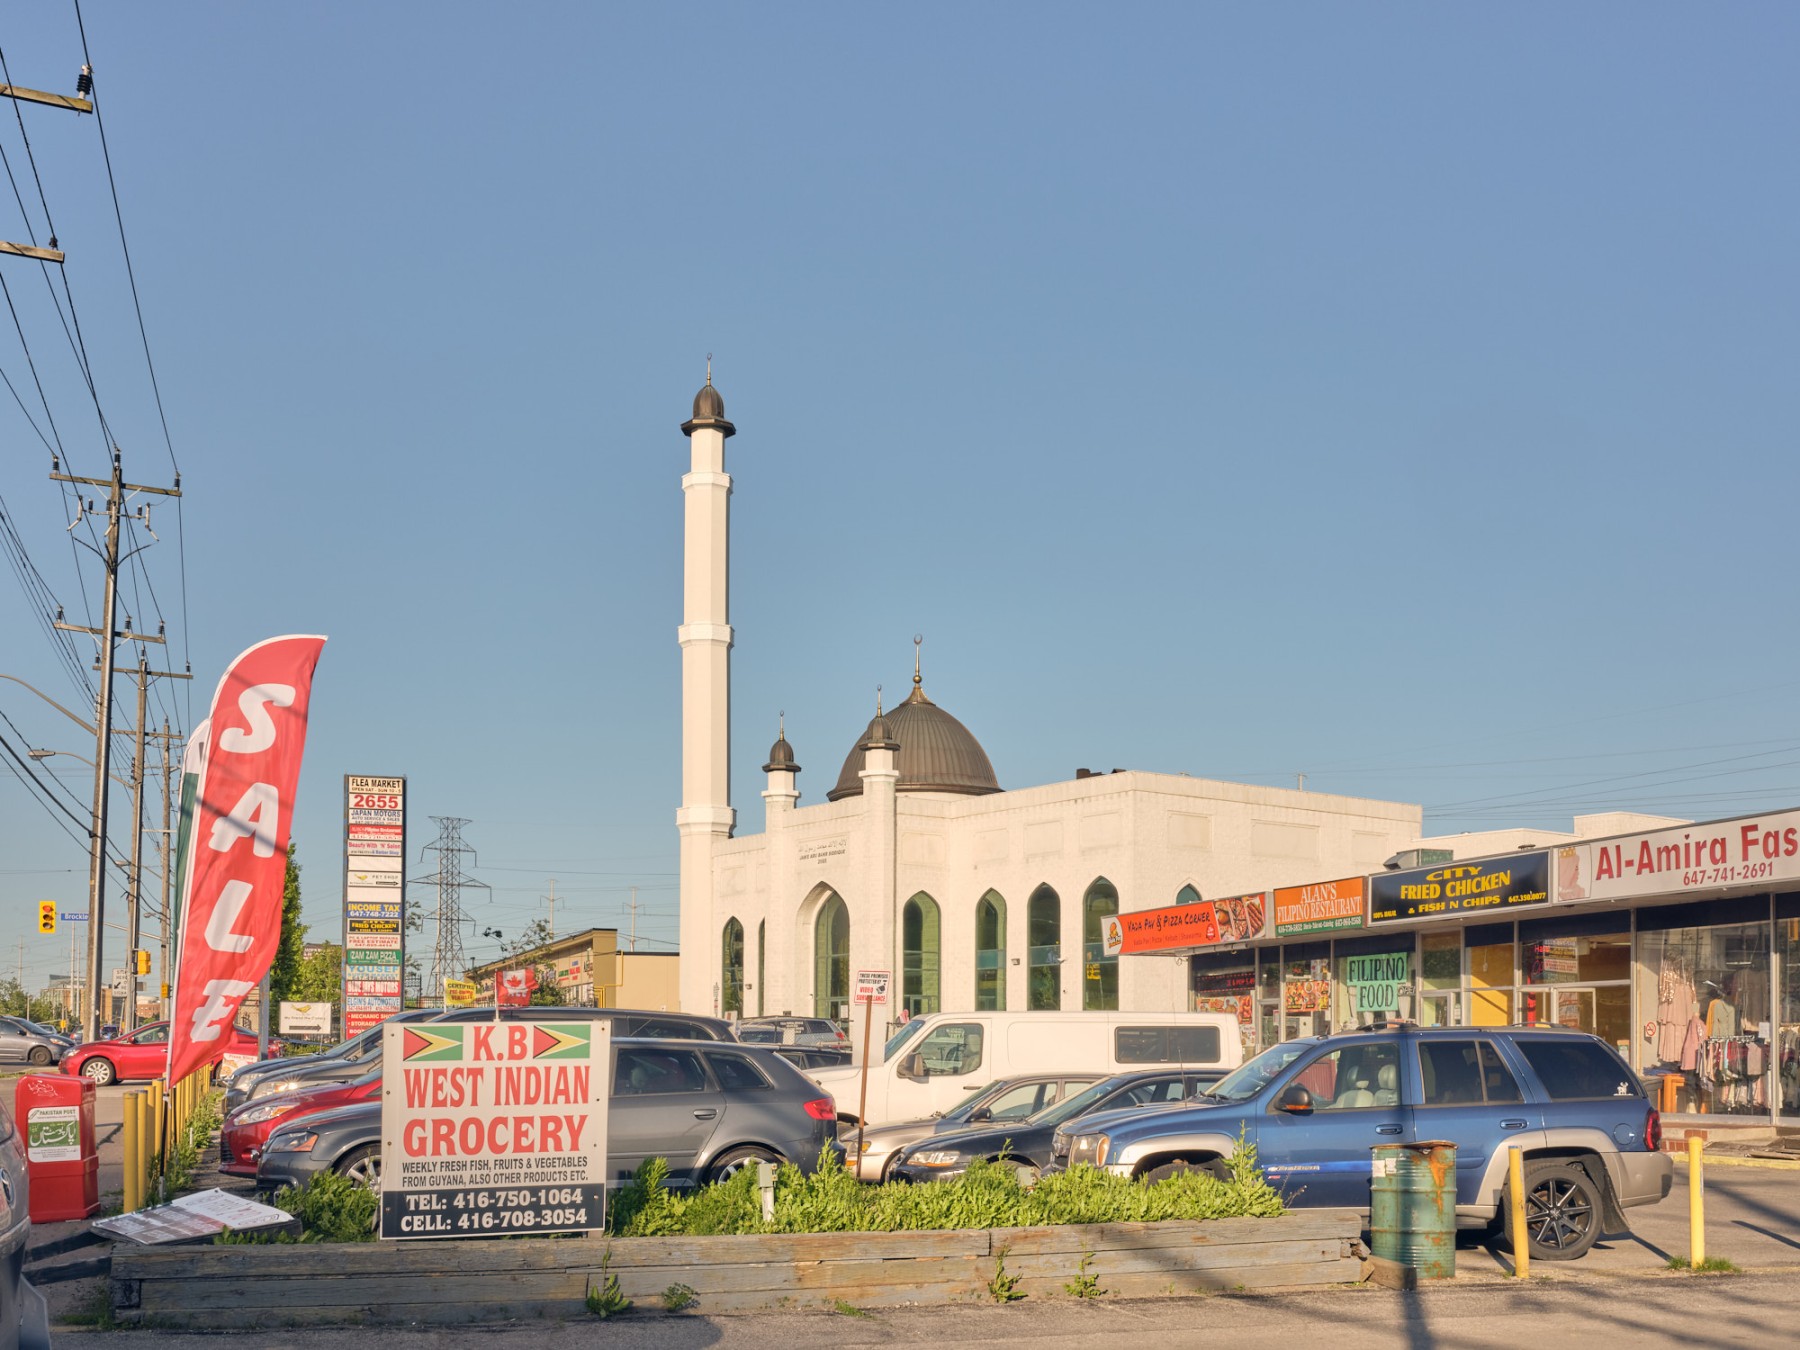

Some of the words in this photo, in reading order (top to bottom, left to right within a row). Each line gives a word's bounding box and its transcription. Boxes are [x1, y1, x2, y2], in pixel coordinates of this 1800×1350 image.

[351, 778, 369, 787] FLEA
[371, 779, 401, 788] MARKET
[353, 794, 399, 808] 2655
[190, 683, 296, 1042] SALE
[1596, 834, 1727, 881] Al-Amira
[1741, 824, 1798, 862] Fas
[1400, 883, 1441, 899] FRIED
[1445, 870, 1510, 897] CHICKEN
[1426, 866, 1482, 881] CITY
[1683, 861, 1773, 886] 647-741-2691
[1300, 882, 1337, 903] ALAN'S
[1418, 902, 1446, 912] FISH
[1449, 900, 1459, 909] N
[1462, 895, 1500, 907] CHIPS
[348, 903, 381, 911] INCOME
[1277, 903, 1310, 923] FILIPINO
[1310, 896, 1361, 918] RESTAURANT
[1156, 915, 1162, 932] &
[365, 951, 379, 960] ZAM
[380, 951, 397, 960] PIZZA
[1349, 956, 1405, 982] FILIPINO
[375, 981, 399, 993] MOTORS
[1360, 984, 1394, 1008] FOOD
[368, 997, 400, 1006] AUTOMOTIVE
[472, 1025, 528, 1061] K.B
[403, 1067, 484, 1108] WEST
[494, 1066, 590, 1106] INDIAN
[403, 1115, 588, 1157] GROCERY
[402, 1161, 437, 1174] WEEKLY
[440, 1160, 467, 1172] FRESH
[470, 1160, 492, 1172] FISH,
[493, 1158, 524, 1170] FRUITS
[526, 1158, 532, 1169] &
[535, 1156, 588, 1169] VEGETABLES
[402, 1175, 427, 1188] FROM
[429, 1174, 466, 1187] GUYANA,
[468, 1173, 491, 1185] ALSO
[493, 1172, 521, 1184] OTHER
[524, 1170, 568, 1183] PRODUCTS
[570, 1170, 588, 1182] ETC.
[406, 1194, 447, 1211] TEL:
[453, 1188, 583, 1208] 416-750-1064
[401, 1215, 451, 1232] CELL:
[458, 1208, 587, 1229] 416-708-3054
